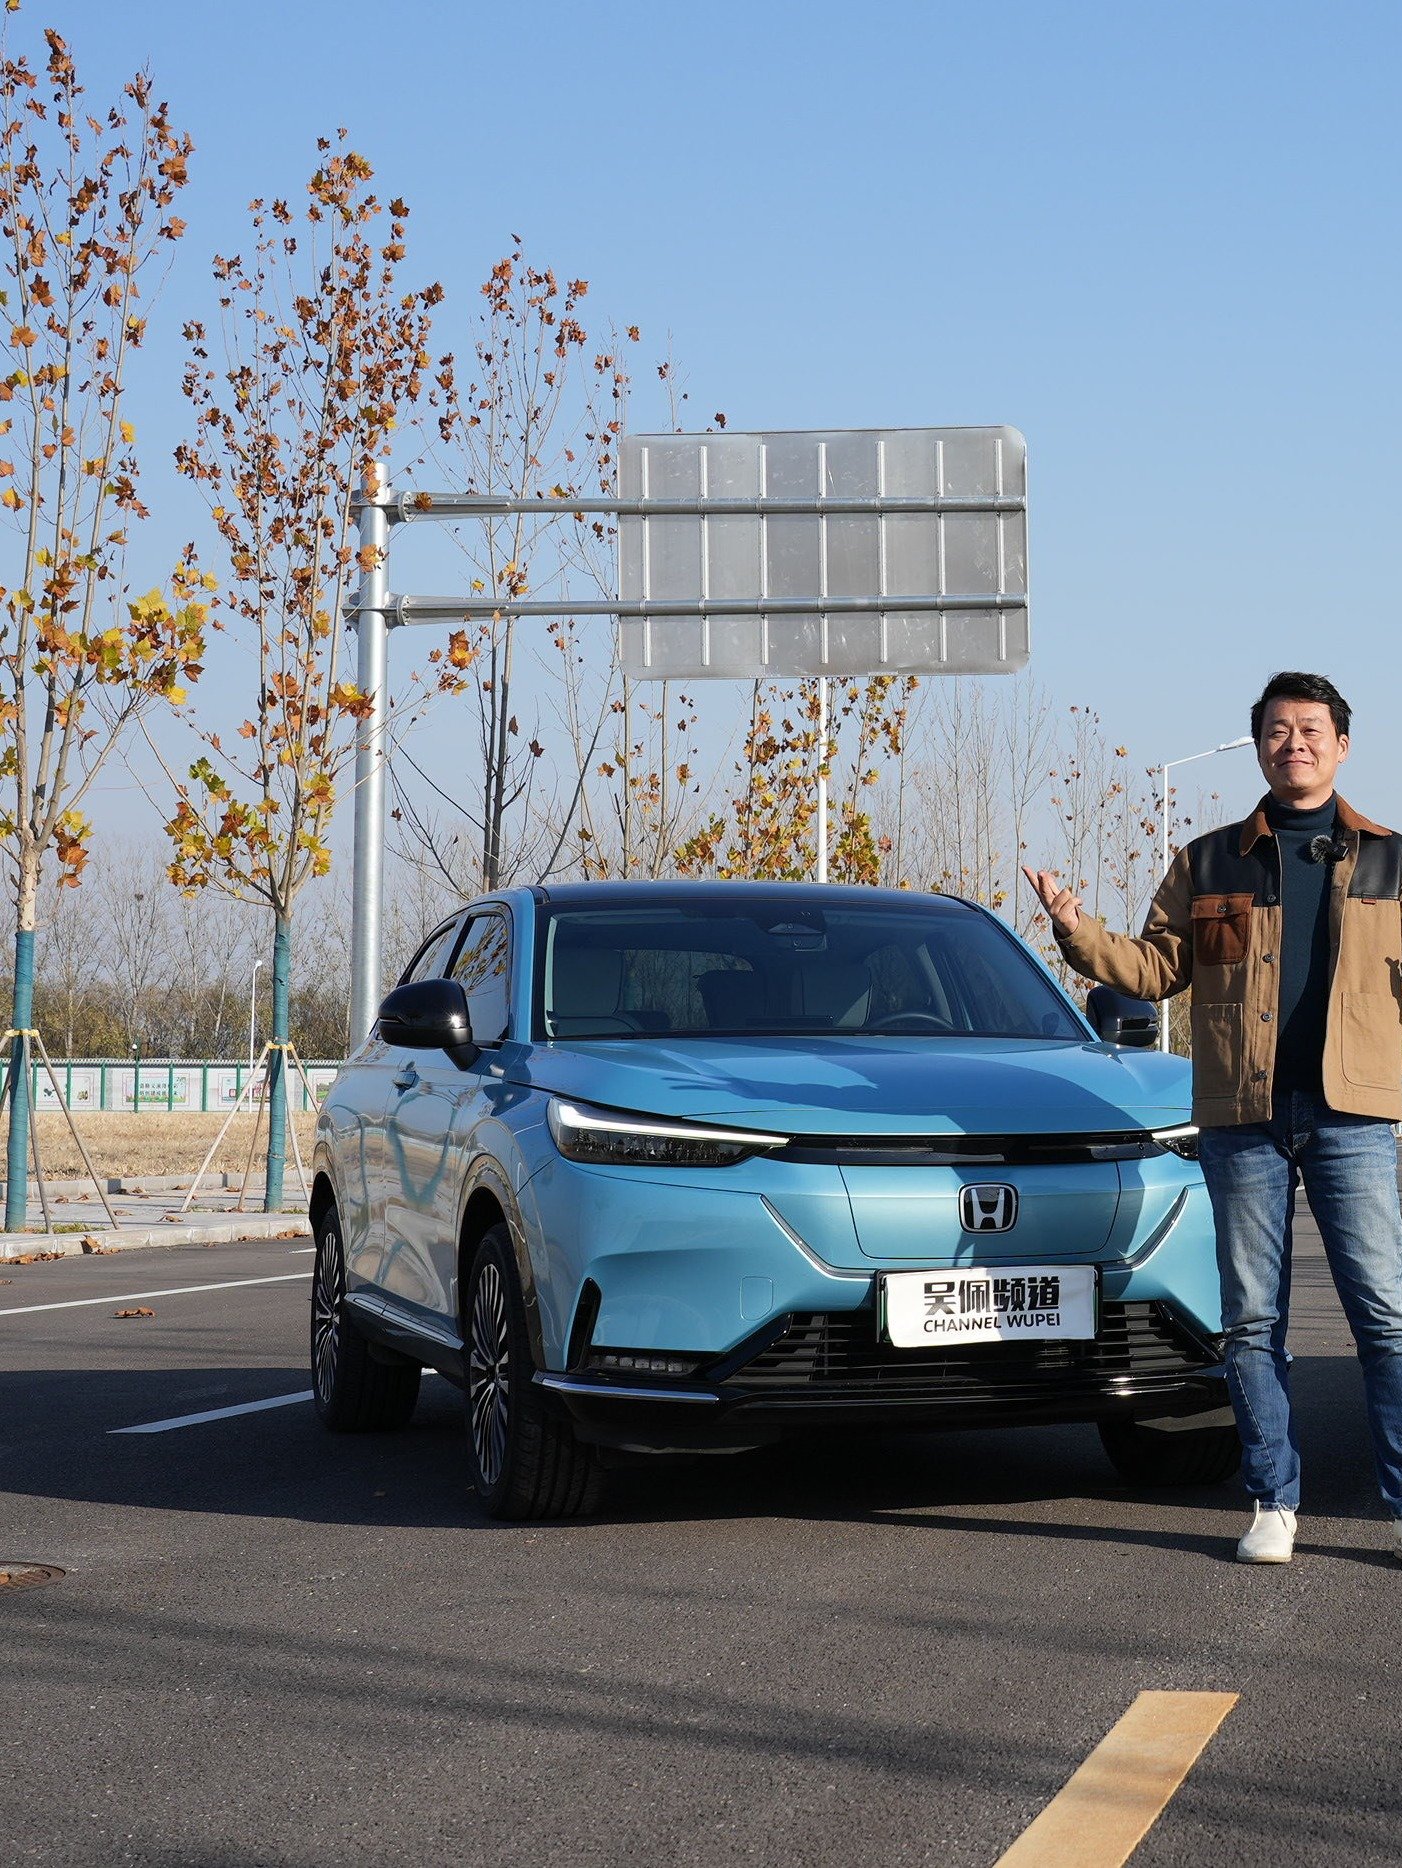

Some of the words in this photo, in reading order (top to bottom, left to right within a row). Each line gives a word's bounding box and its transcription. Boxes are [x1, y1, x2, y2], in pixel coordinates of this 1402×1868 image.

[924, 1276, 1060, 1315] 吴佩频道
[923, 1317, 1002, 1333] CHANNEL
[1006, 1313, 1061, 1328] WUPEI
